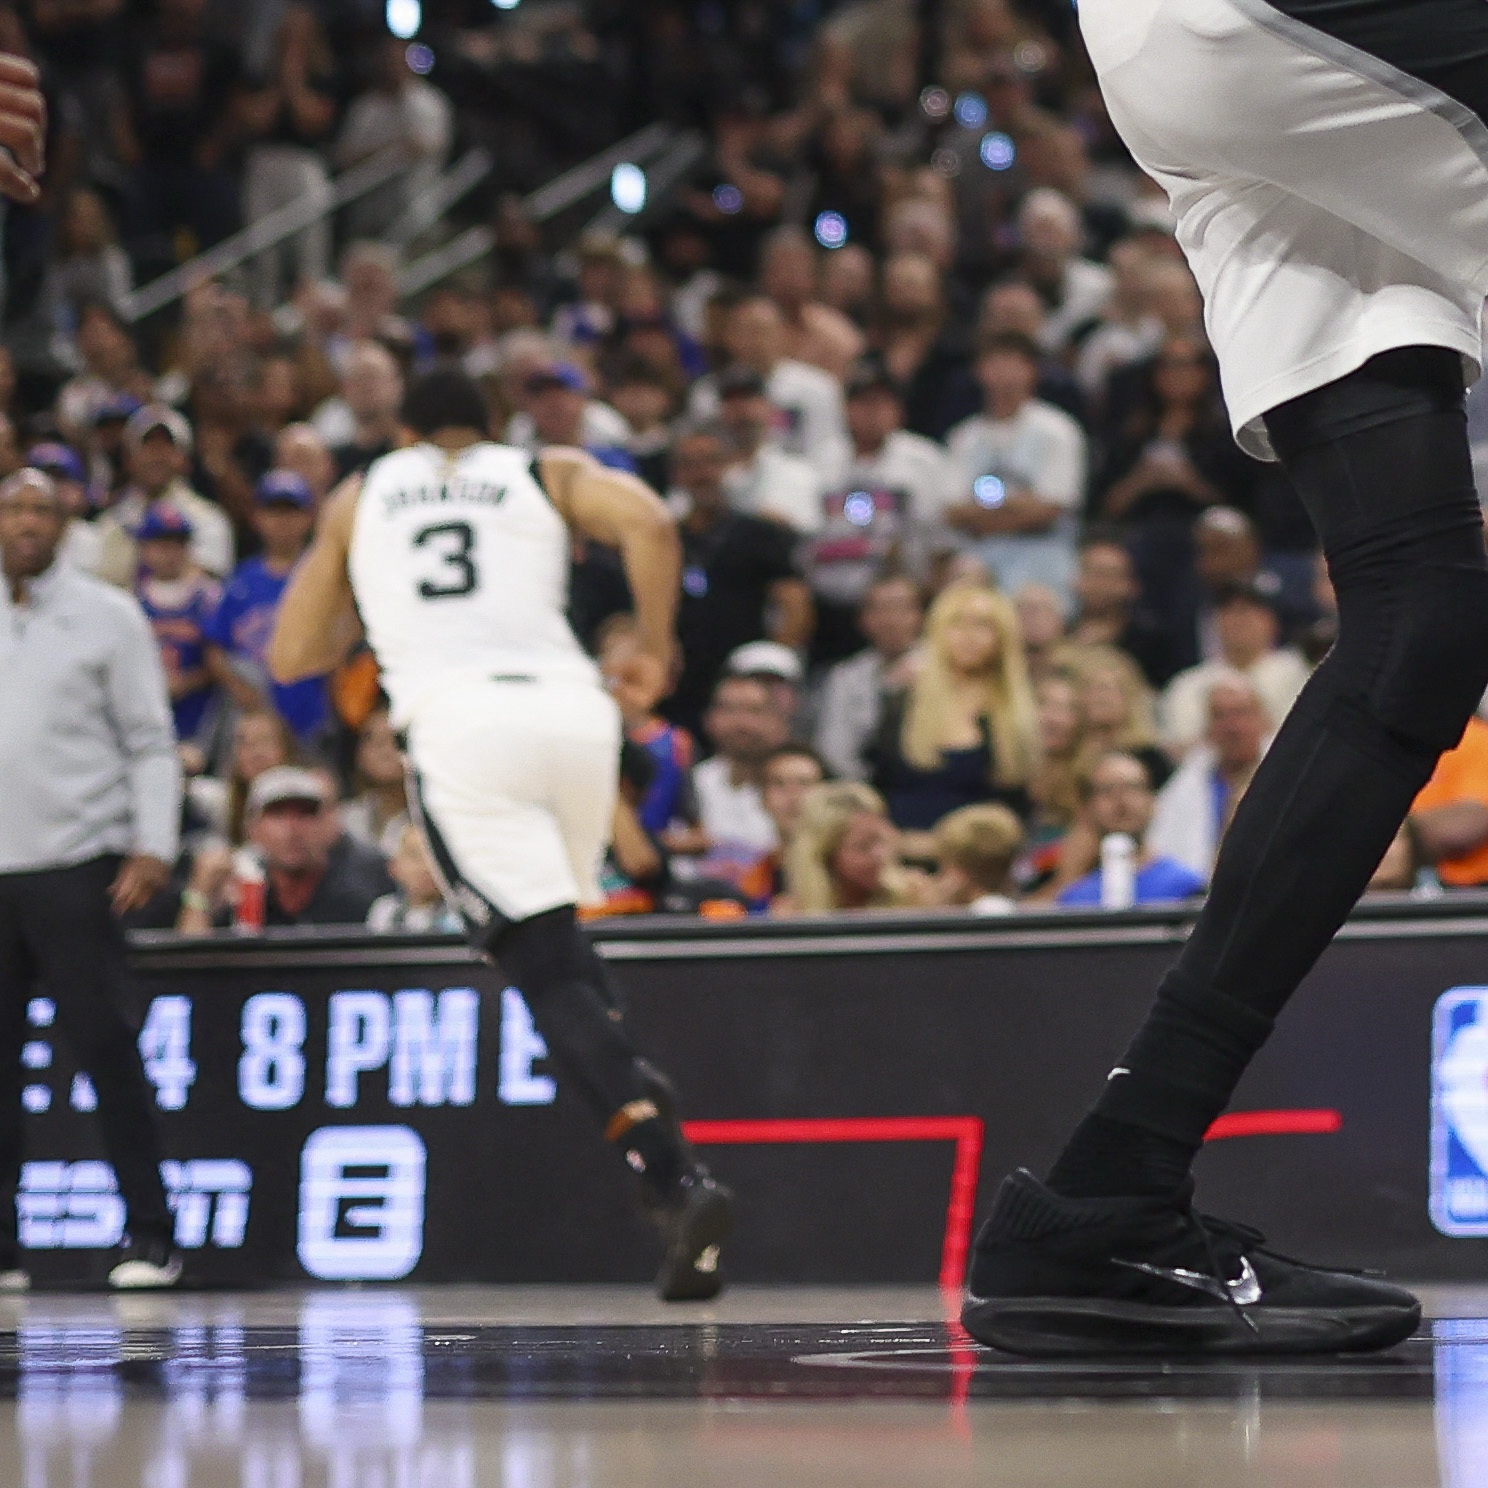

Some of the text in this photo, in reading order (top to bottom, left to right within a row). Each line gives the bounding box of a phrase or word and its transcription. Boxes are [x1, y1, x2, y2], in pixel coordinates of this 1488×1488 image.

[413, 520, 478, 599] 3
[237, 991, 308, 1111] 8
[323, 987, 481, 1109] PM
[15, 1159, 254, 1250] ESN
